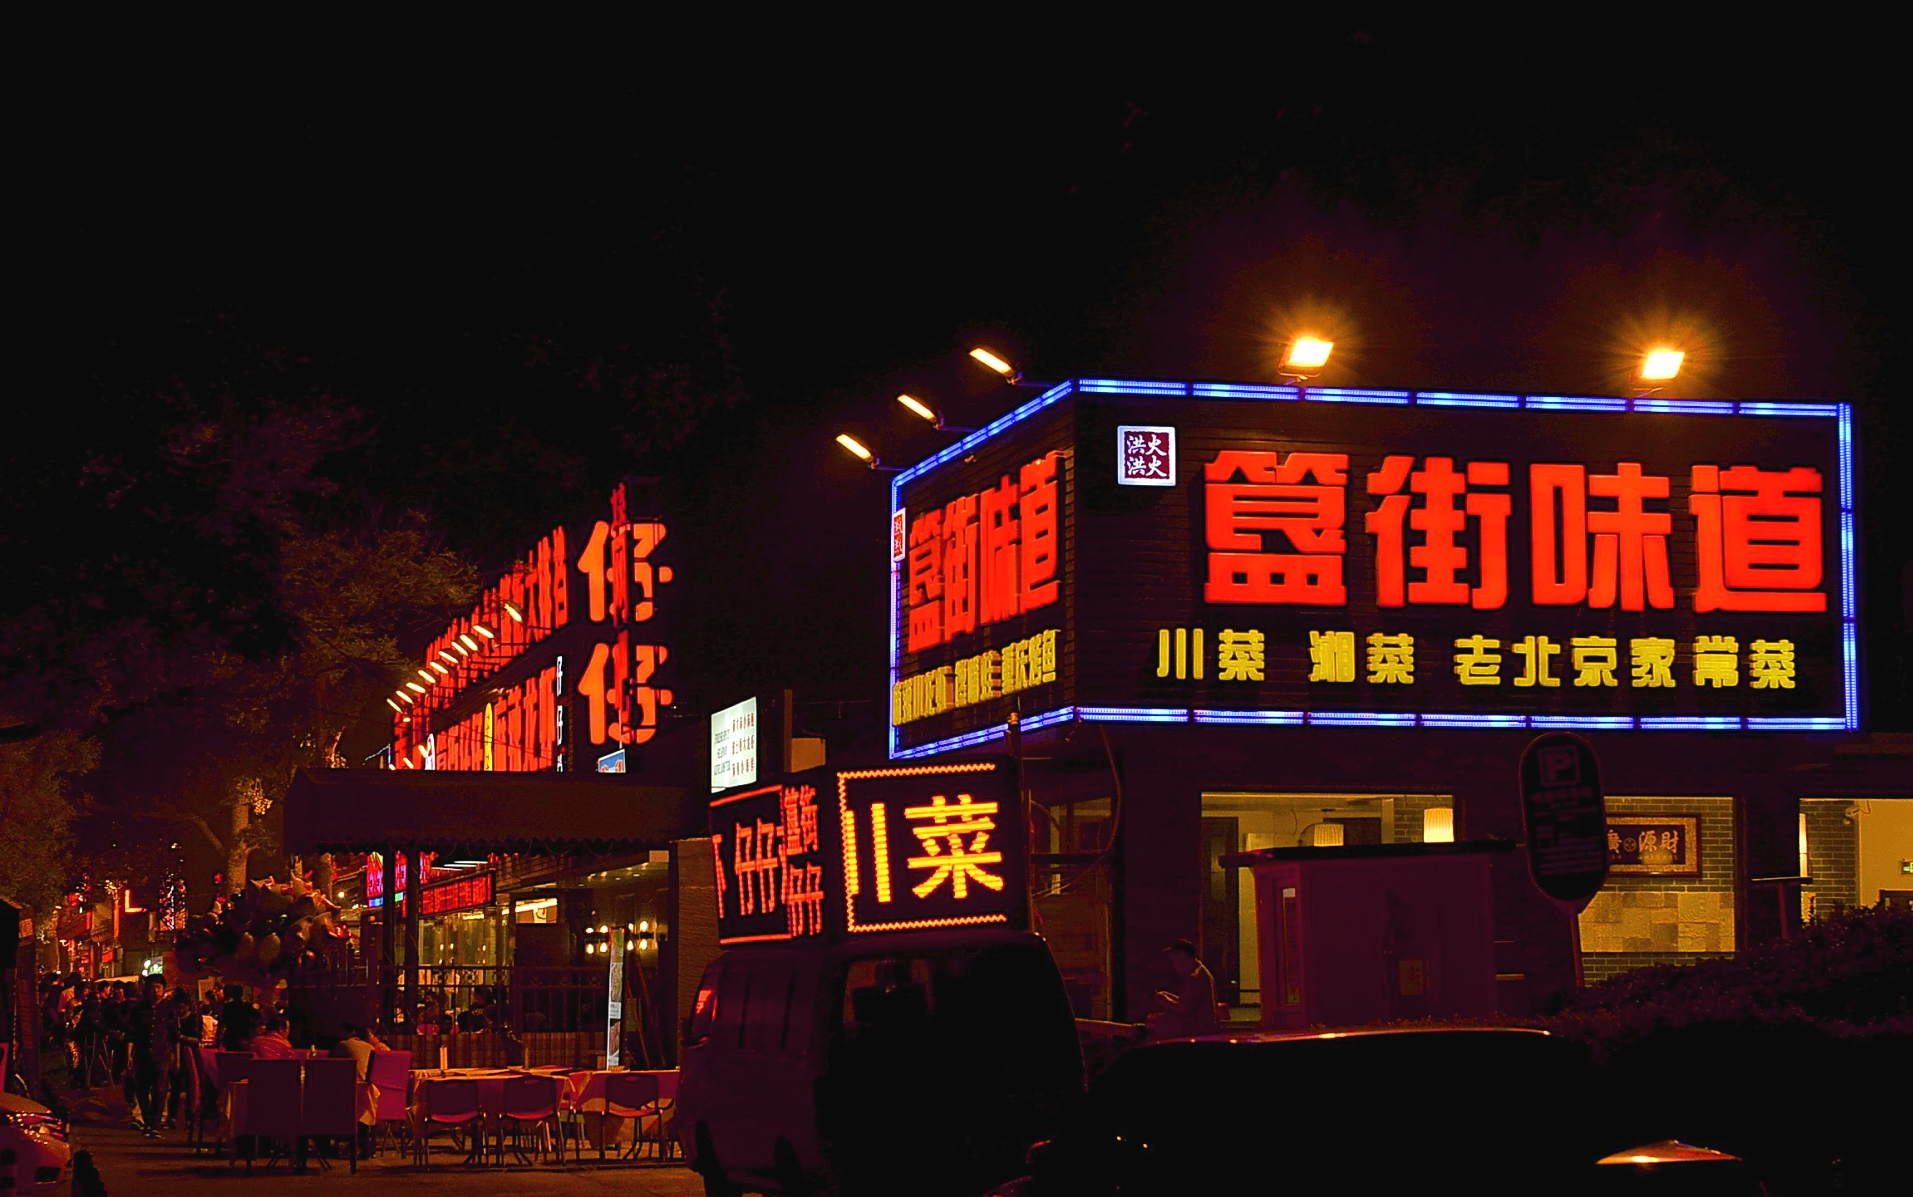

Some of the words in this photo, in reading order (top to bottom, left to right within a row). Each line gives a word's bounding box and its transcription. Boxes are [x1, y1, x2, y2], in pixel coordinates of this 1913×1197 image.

[908, 450, 1061, 654] 簋街味道
[1204, 449, 1828, 614] 簋街味道
[1157, 627, 1265, 682] 川菜
[1309, 630, 1415, 685] 湘菜
[1454, 634, 1797, 690] 老北京家常菜
[1546, 751, 1573, 783] P
